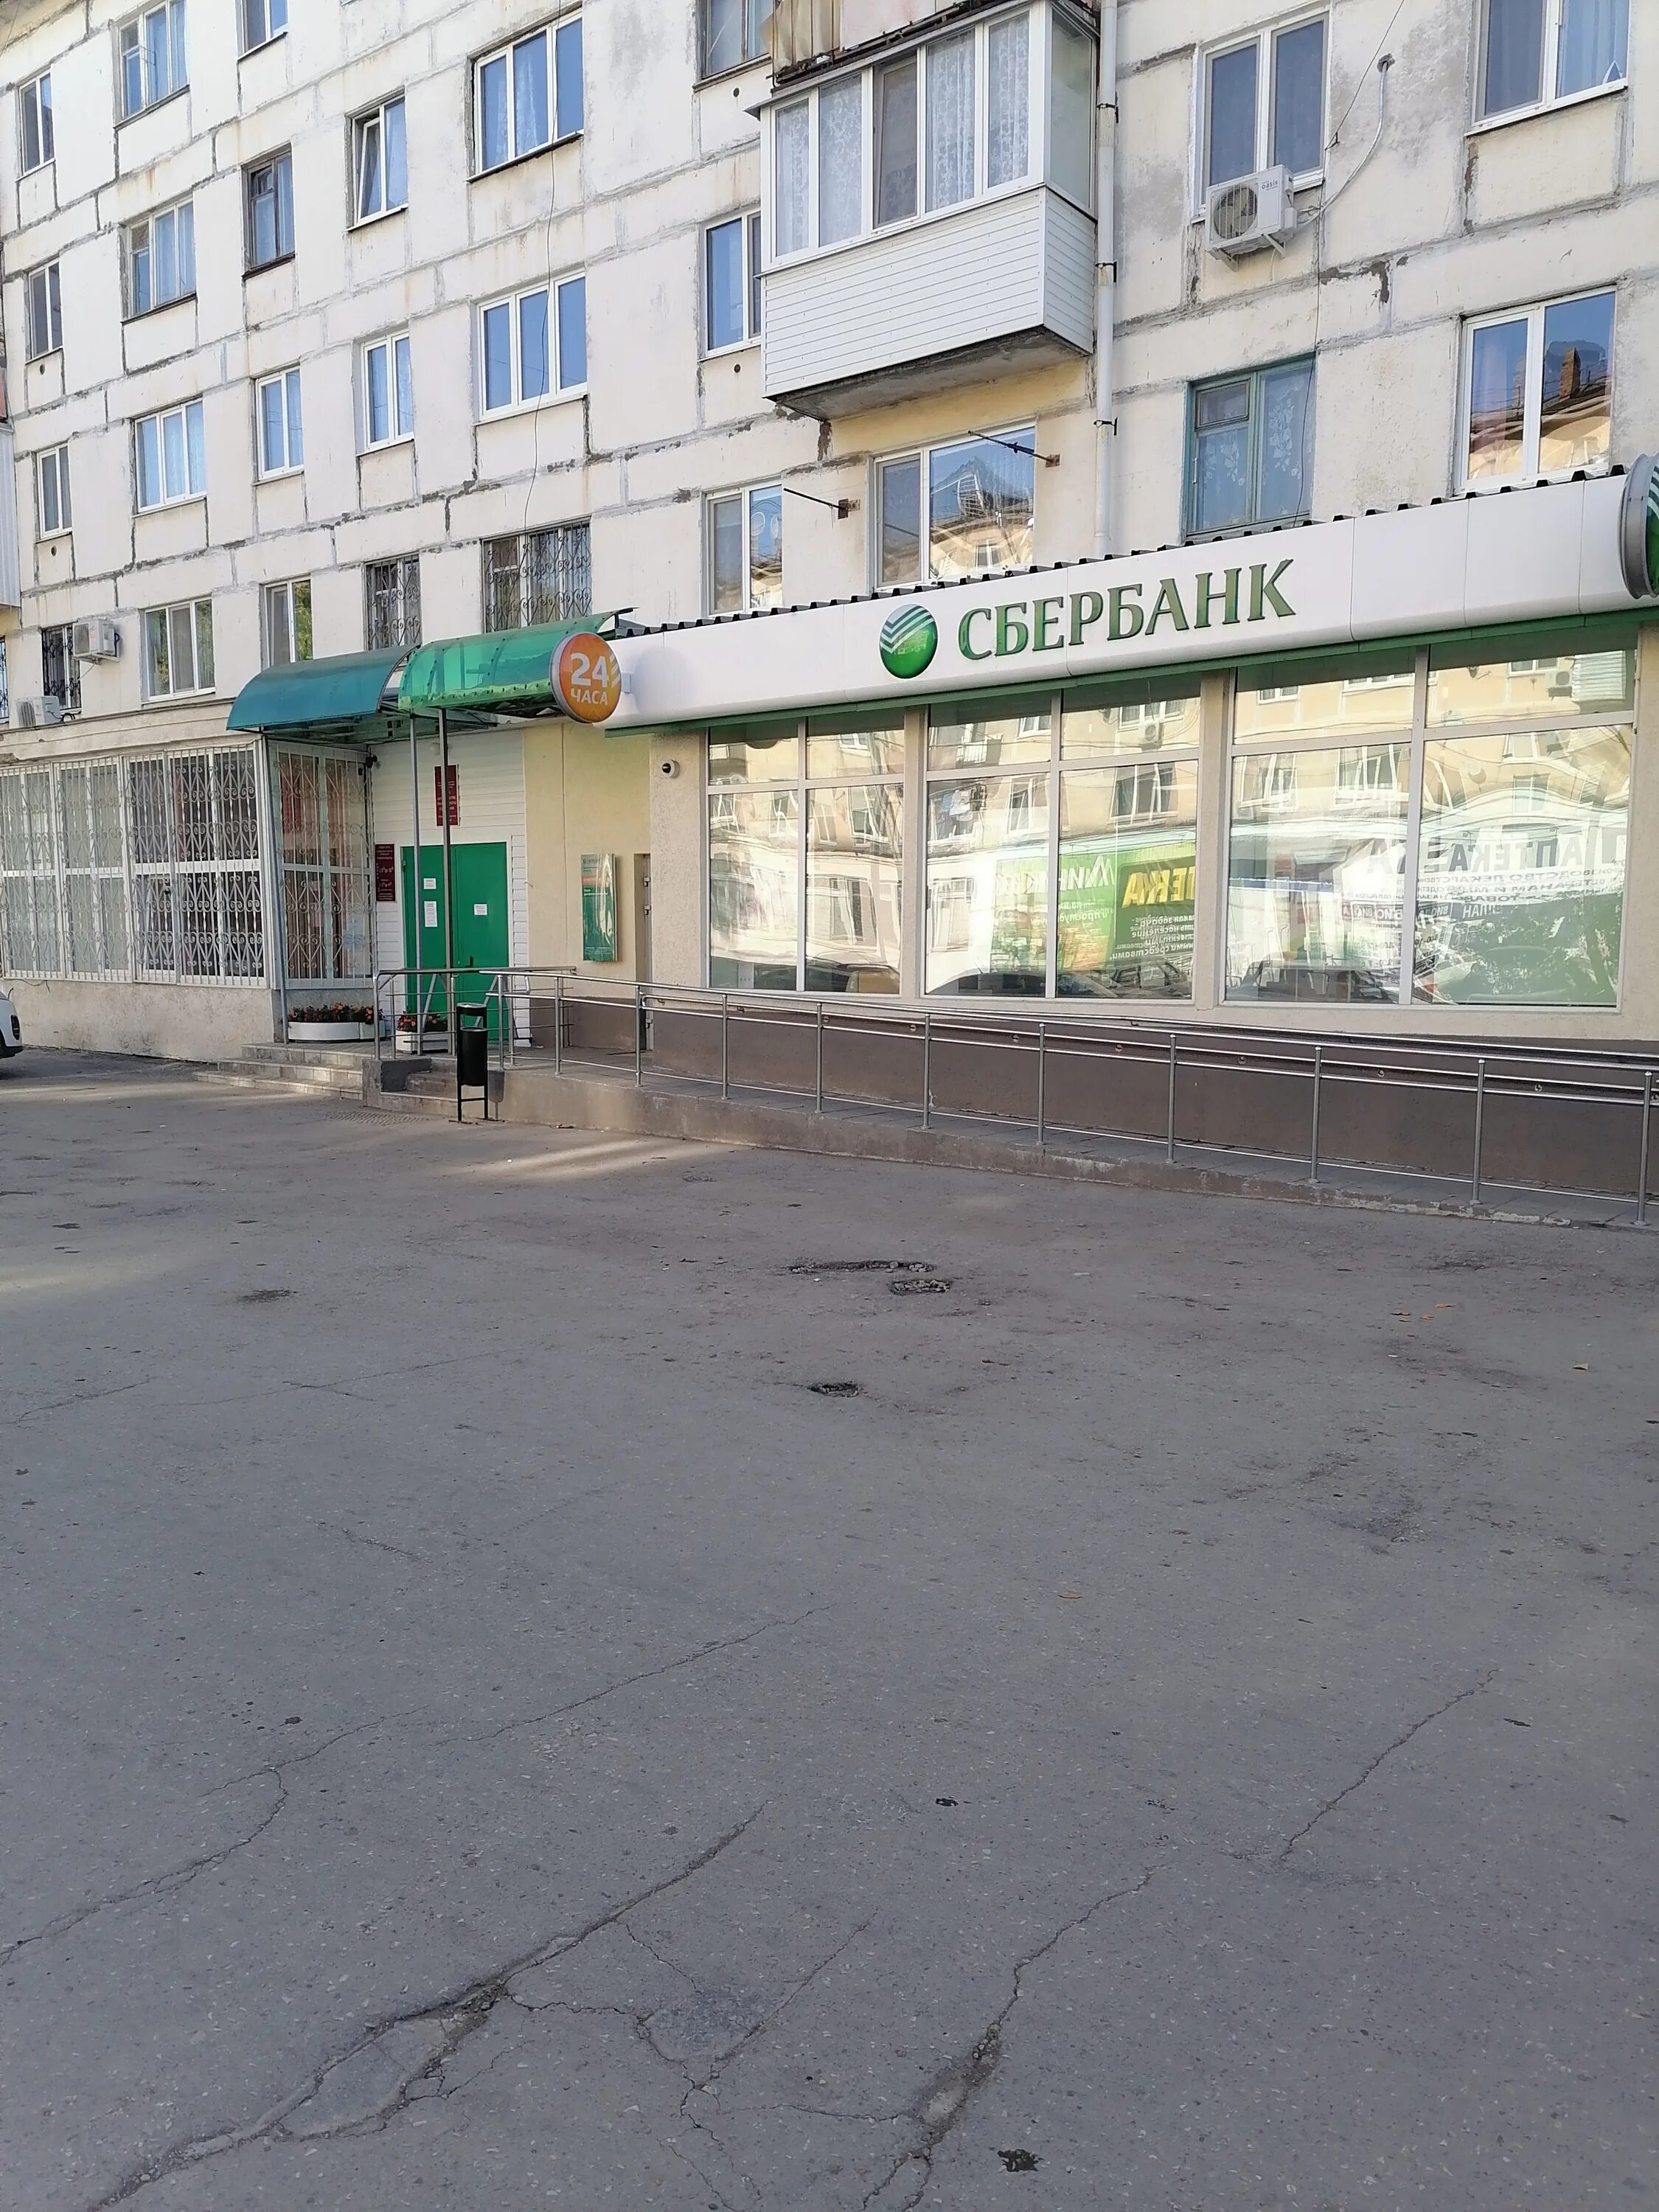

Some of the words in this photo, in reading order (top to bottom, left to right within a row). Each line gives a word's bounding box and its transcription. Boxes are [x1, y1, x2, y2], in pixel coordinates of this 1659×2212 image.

[957, 559, 1296, 661] СБЕРБАНК
[571, 652, 609, 688] 24
[571, 688, 608, 705] ЧАСА
